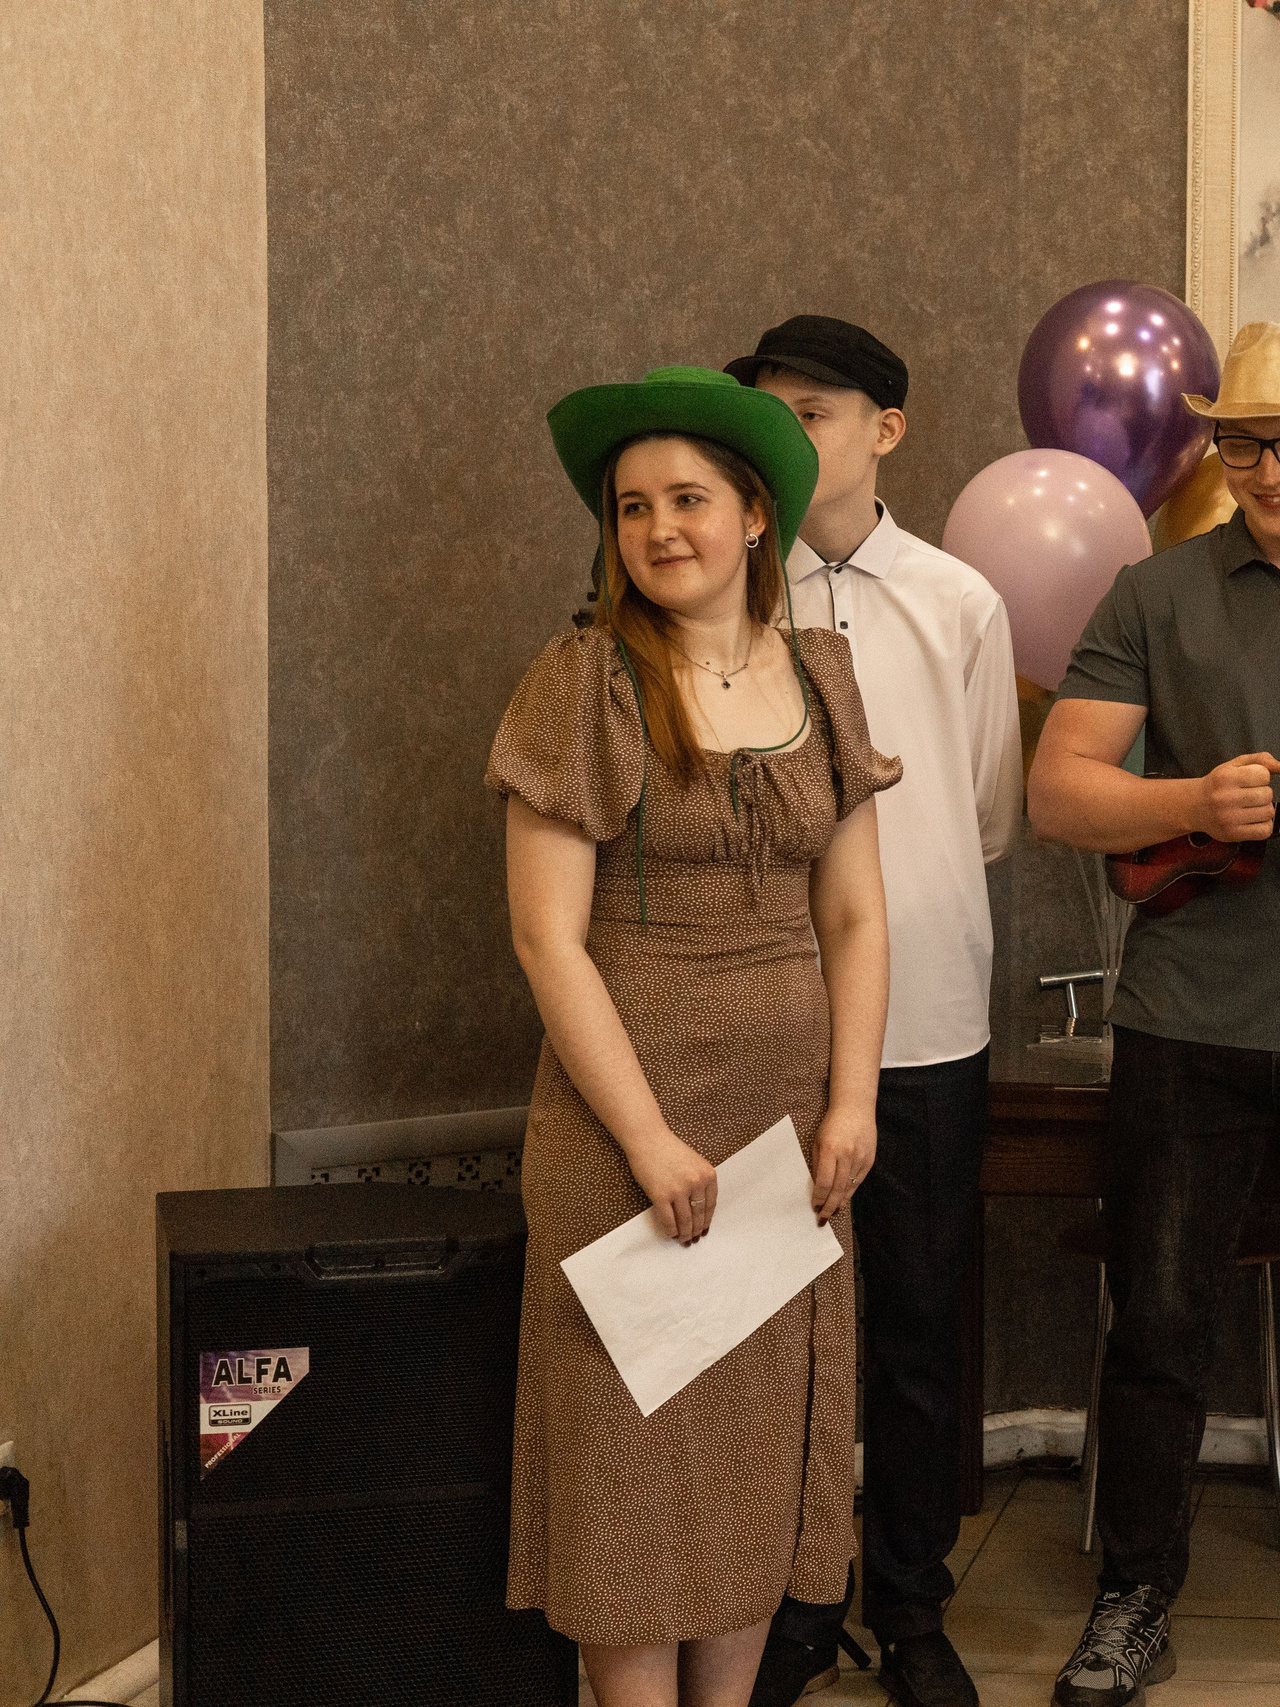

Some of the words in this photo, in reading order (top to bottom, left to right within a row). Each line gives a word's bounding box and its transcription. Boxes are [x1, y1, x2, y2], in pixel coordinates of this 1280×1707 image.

[211, 1356, 293, 1387] ALFA
[253, 1386, 281, 1395] SERIES
[212, 1409, 248, 1417] XLine
